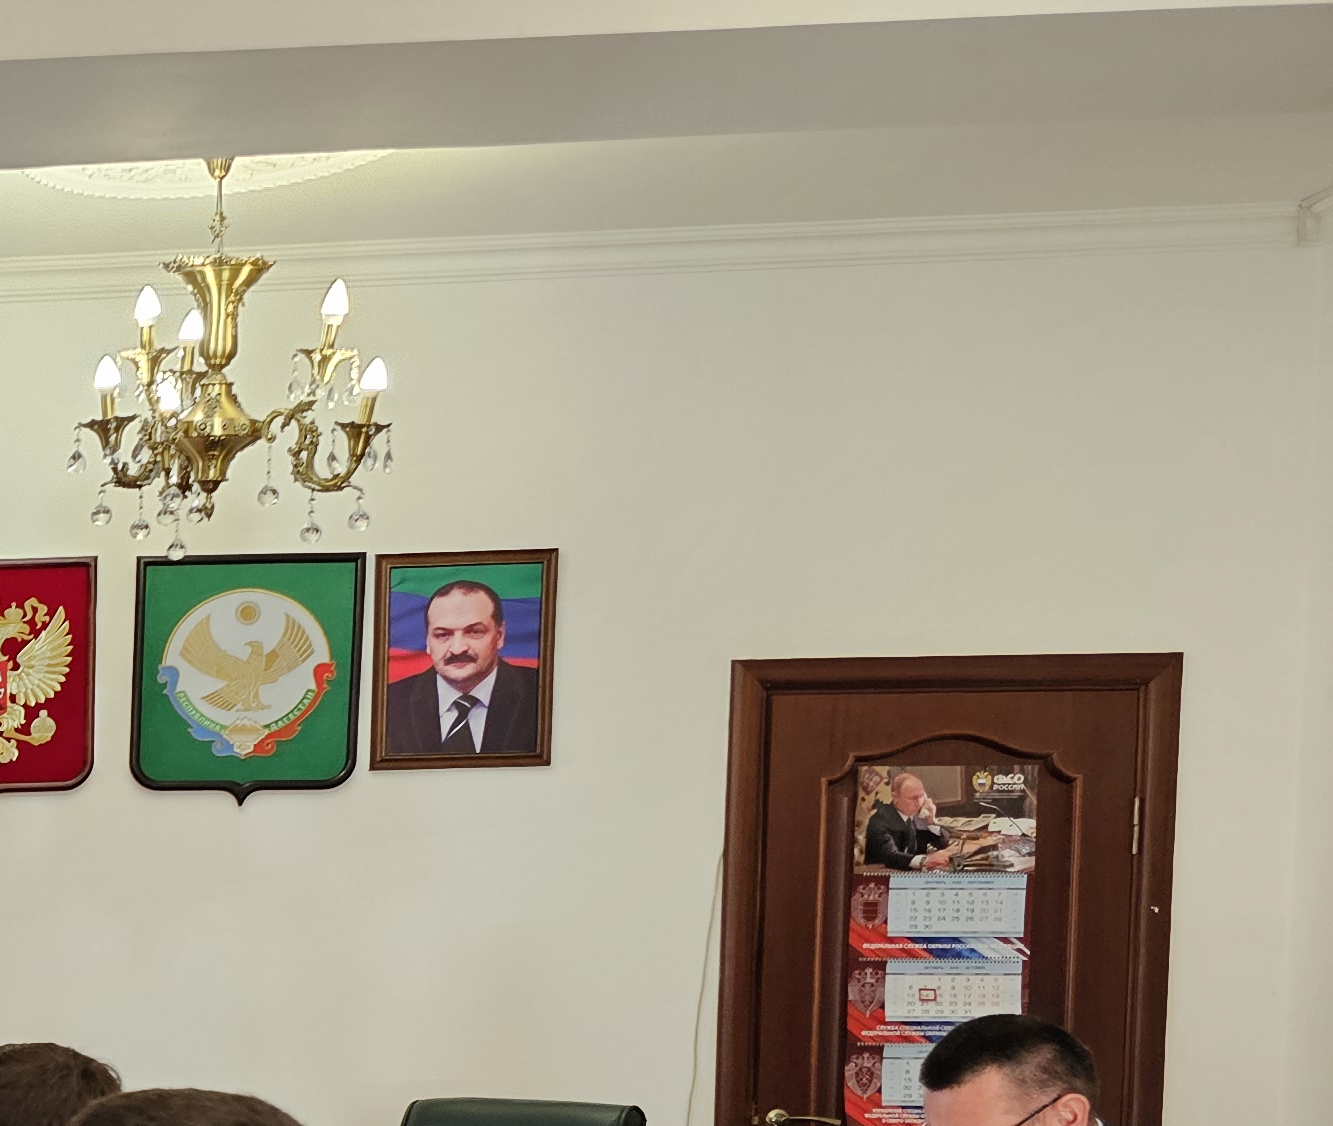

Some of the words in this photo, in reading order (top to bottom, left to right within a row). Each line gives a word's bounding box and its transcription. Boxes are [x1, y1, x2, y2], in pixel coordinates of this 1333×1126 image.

[176, 692, 221, 732] РЕСПУБЛИКА
[269, 691, 314, 731] ДАГЕСТАН
[994, 774, 1024, 784] ФСО
